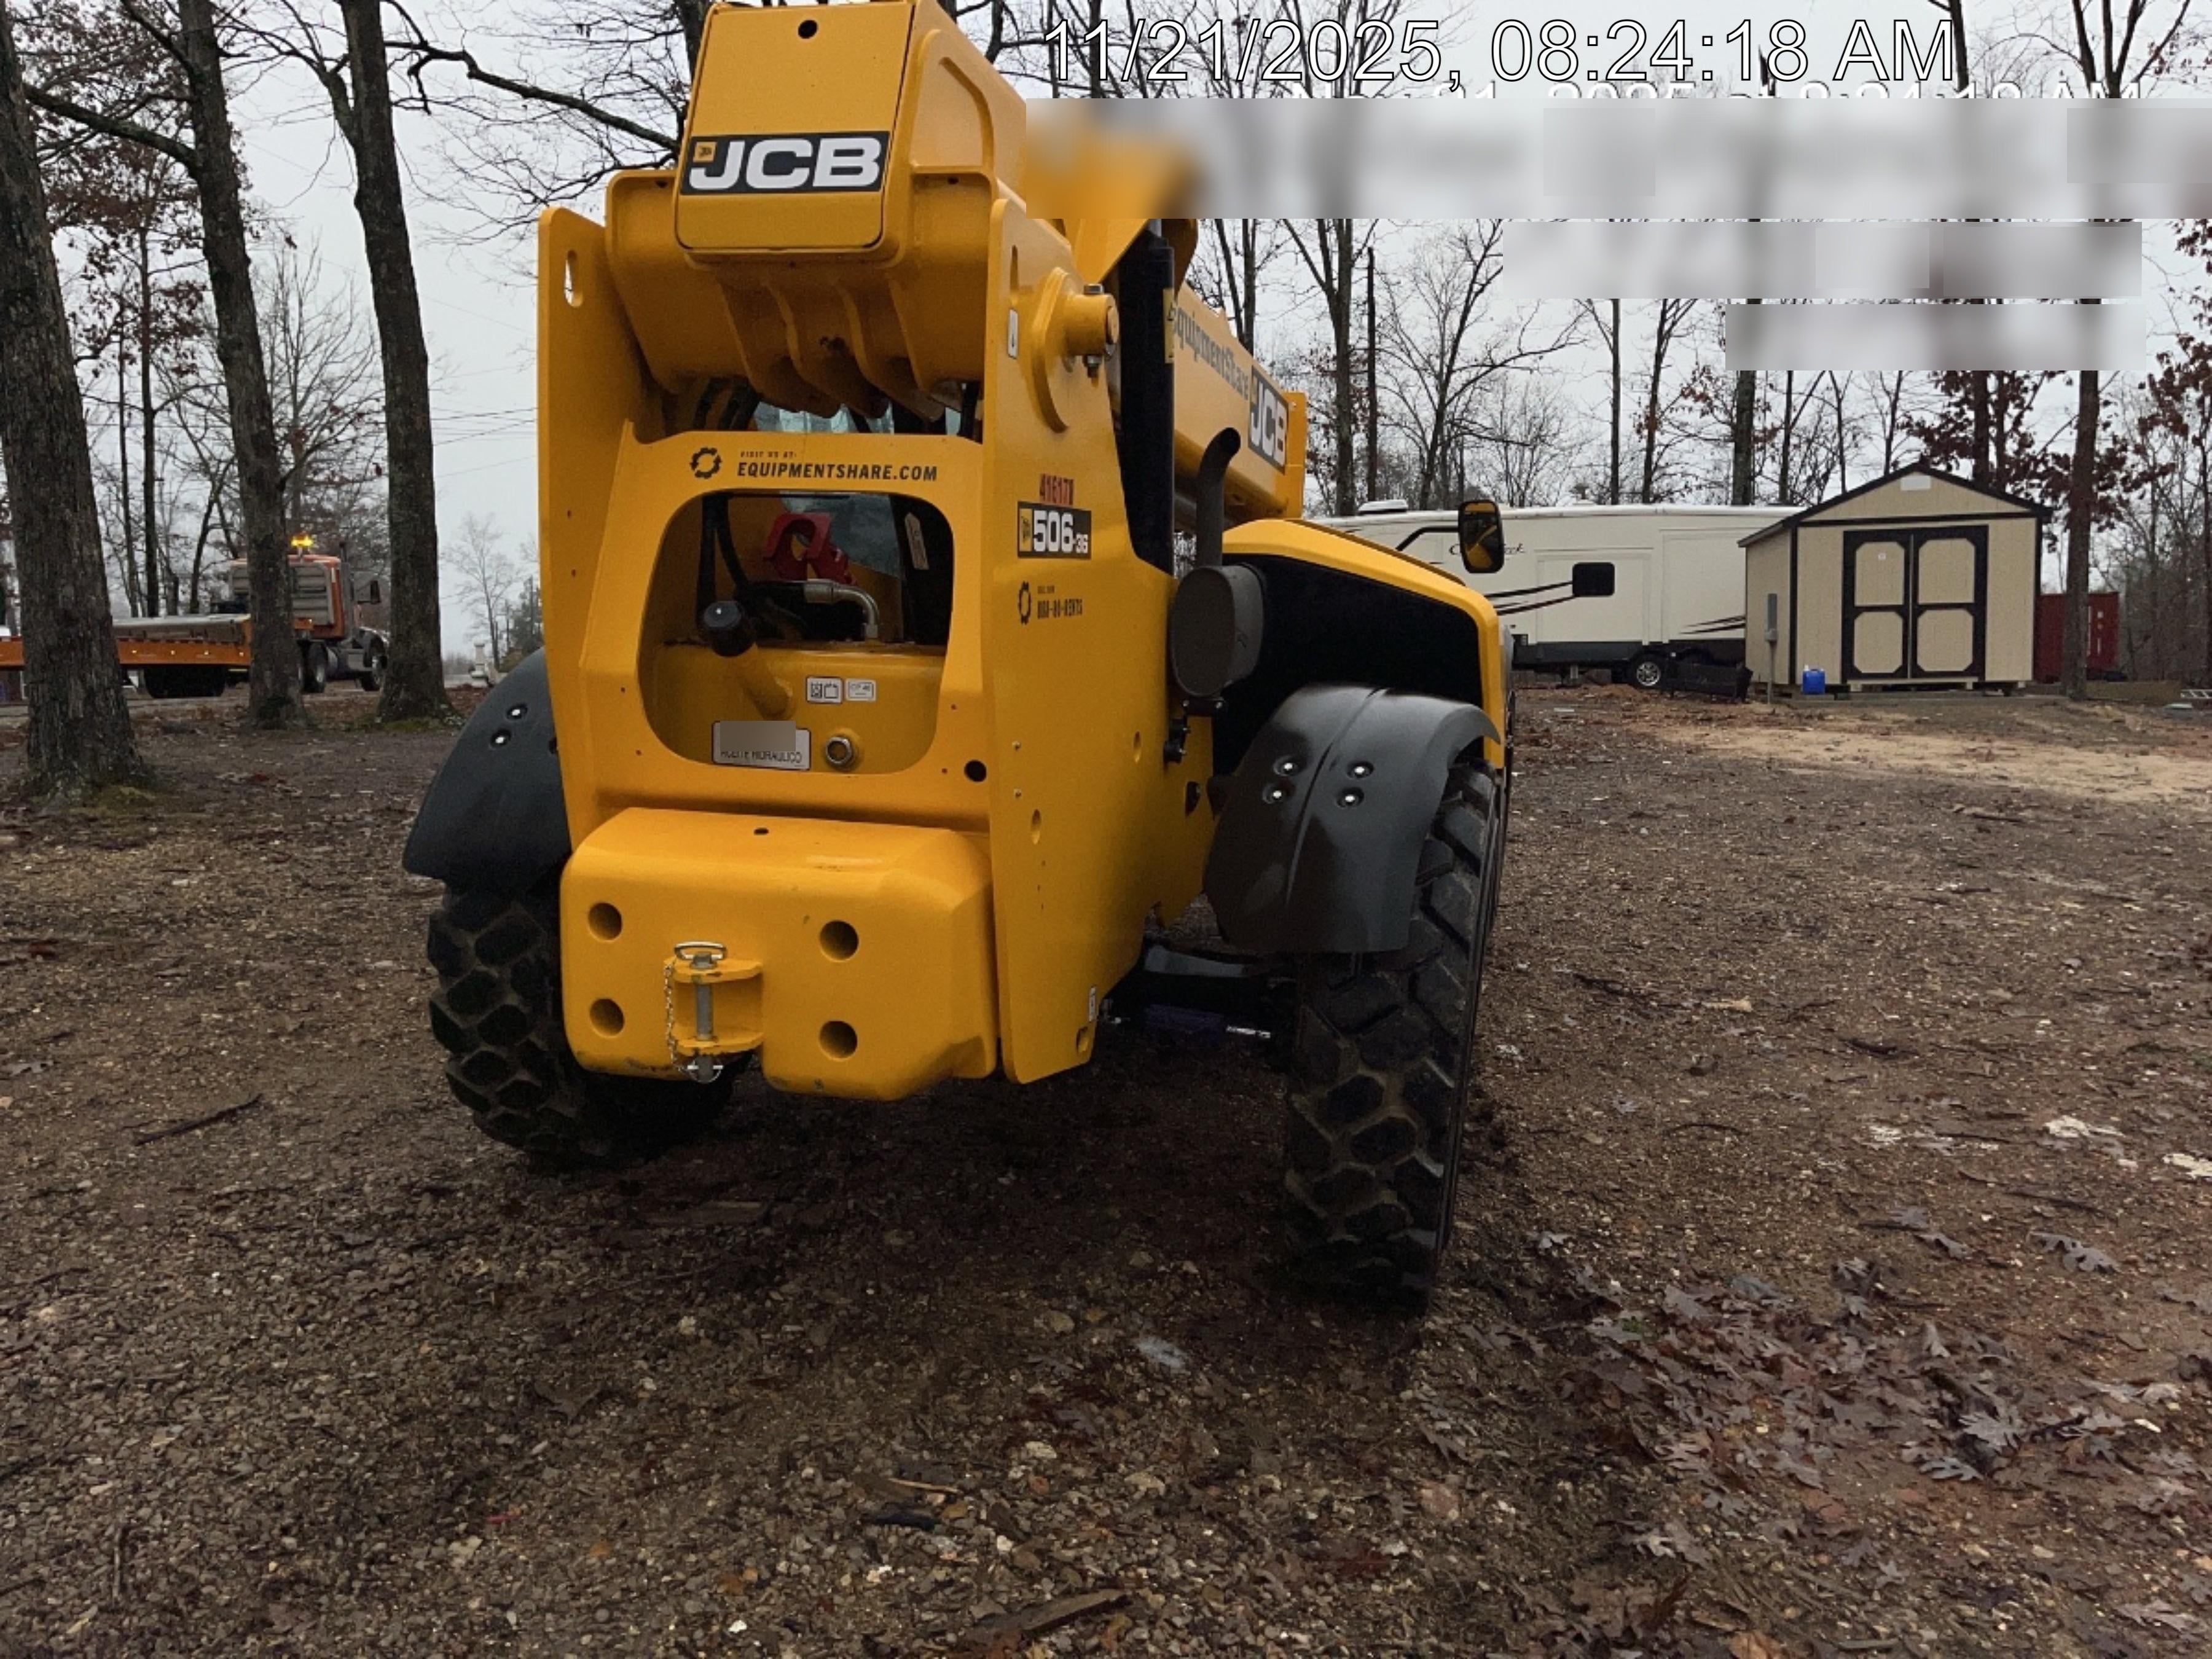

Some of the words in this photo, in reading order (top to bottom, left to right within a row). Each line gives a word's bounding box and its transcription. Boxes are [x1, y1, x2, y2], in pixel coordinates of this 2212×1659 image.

[689, 138, 882, 190] JCB
[1250, 379, 1288, 468] JCB
[737, 461, 938, 481] EQUIPMENTSHARE.COM
